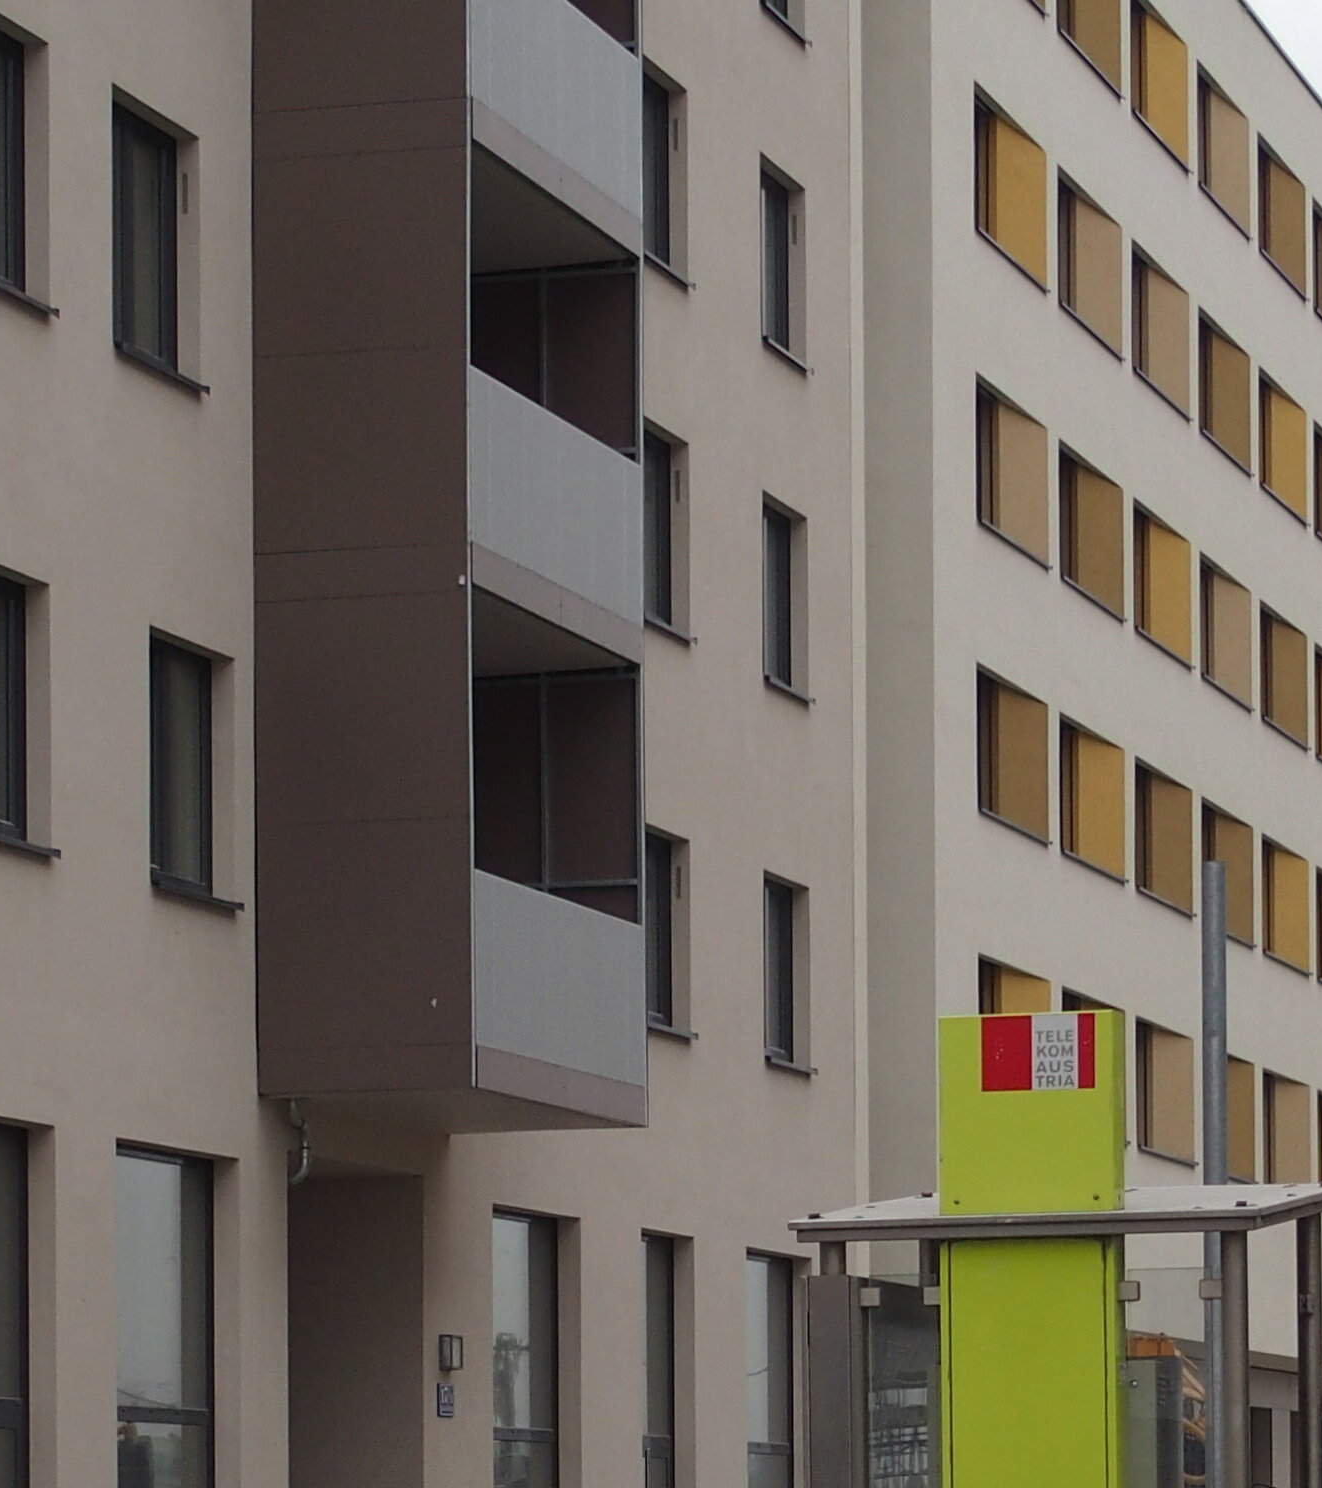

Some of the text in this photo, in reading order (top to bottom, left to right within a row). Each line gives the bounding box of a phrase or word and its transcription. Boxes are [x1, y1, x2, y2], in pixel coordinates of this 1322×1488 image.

[1035, 1030, 1074, 1043] TELE
[1036, 1044, 1074, 1058] KOM
[1036, 1060, 1074, 1073] AUS
[1035, 1075, 1075, 1088] TRIA
